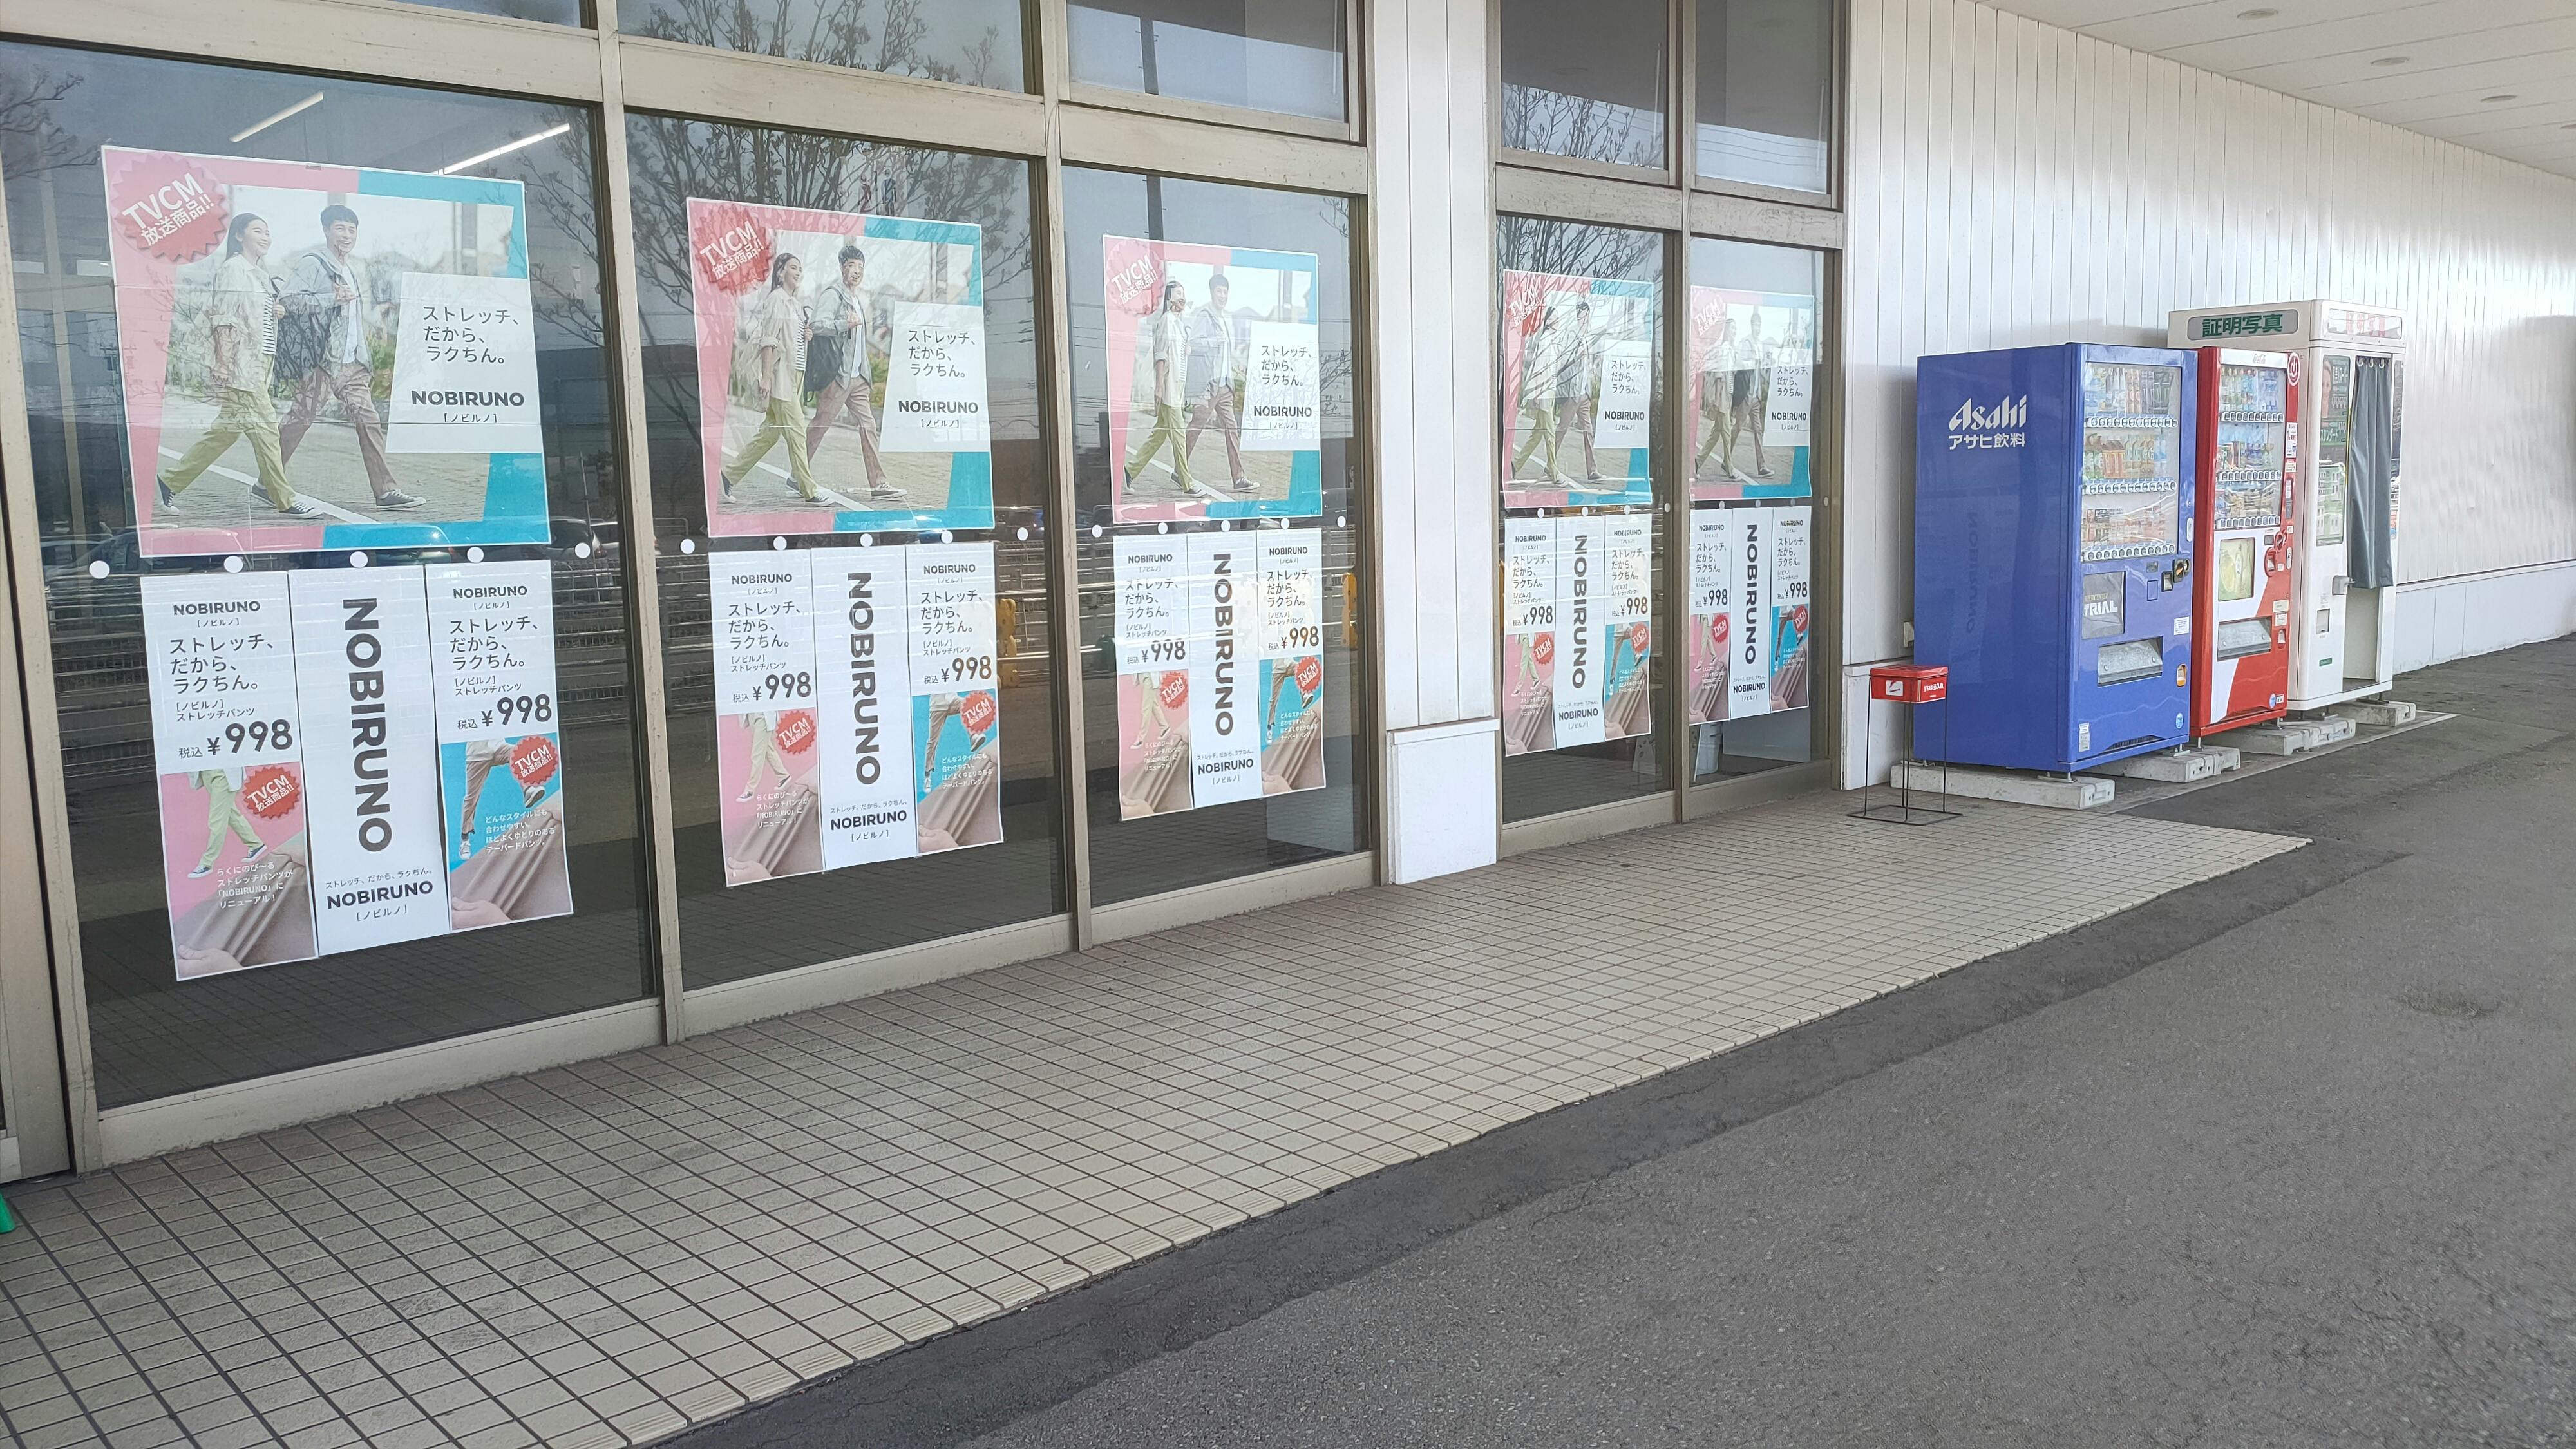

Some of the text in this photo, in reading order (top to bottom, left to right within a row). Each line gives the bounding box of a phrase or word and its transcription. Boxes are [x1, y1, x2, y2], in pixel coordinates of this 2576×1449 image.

[122, 173, 204, 229] TVCM
[699, 220, 757, 266] TVCM
[1111, 254, 1153, 292] TVCM
[423, 306, 518, 325] ストレッチ、
[2202, 314, 2283, 337] 証明写真
[423, 326, 484, 343] だから、
[908, 330, 976, 346] ストレッチ、
[426, 346, 504, 364] ラクちん。
[908, 346, 952, 362] だから、
[1262, 345, 1311, 357] ストレッチ、
[910, 363, 965, 378] ラクちん。
[1262, 359, 1293, 371] だから、
[1262, 374, 1303, 386] ラクちん。
[1611, 372, 1634, 382] だから、
[1777, 377, 1797, 386] だから、
[411, 390, 524, 406] NOBIRUNO
[1777, 388, 1803, 397] ラクちん。
[898, 401, 978, 413] NOBIRUNO
[1254, 406, 1312, 417] NOBIRUNO
[1949, 394, 2027, 431] Asahi
[1605, 410, 1645, 421] NOBIRUNO
[1772, 412, 1806, 421] NOBIRUNO
[1949, 432, 2025, 450] アサヒ飲料
[1128, 554, 1172, 564] NOBIRUNO
[1269, 547, 1308, 556] NOBIRUNO
[1513, 554, 1549, 565] ストレッチ、
[924, 564, 976, 574] NOBIRUNO
[1513, 567, 1536, 577] だから、
[732, 574, 792, 584] NOBIRUNO
[1513, 579, 1544, 589] ラクちん。
[453, 585, 527, 599] NOBIRUNO
[921, 590, 983, 603] ストレッチ、
[1267, 583, 1296, 595] だから、
[1745, 524, 1758, 665] NOBIRUNO
[1125, 593, 1158, 605] だから、
[1267, 595, 1305, 607] ラクちん。
[173, 601, 260, 616] NOBIRUNO
[729, 601, 800, 616] ストレッチ、
[921, 607, 960, 620] だから、
[1126, 606, 1169, 619] ラクちん。
[1572, 535, 1587, 688] NOBIRUNO
[2084, 600, 2118, 617] TRIAL
[450, 616, 538, 634] ストレッチ、
[729, 619, 774, 634] だから、
[922, 621, 972, 634] ラクちん。
[170, 633, 273, 654] ストレッチ、
[450, 636, 507, 653] だから、
[730, 634, 788, 650] ラクちん。
[1213, 553, 1234, 736] NOBIRUNO
[170, 656, 236, 675] だから、
[453, 653, 524, 671] ラクちん。
[731, 662, 786, 672] ストレッチパンツ
[848, 573, 880, 784] NOBIRUNO
[1298, 661, 1317, 681] TVCM
[173, 675, 258, 694] ラクちん。
[455, 683, 522, 696] ストレッチパンツ
[1162, 677, 1183, 698] TVCM
[1733, 682, 1765, 694] NOBIRUNO
[176, 708, 255, 722] ストレッチパンツ
[963, 698, 989, 719] TVCM
[1559, 708, 1598, 721] NOBIRUNO
[343, 598, 392, 853] NOBIRUNO
[457, 719, 478, 730] 税込
[779, 717, 809, 741] TVCM
[178, 747, 203, 759] 税込
[515, 744, 549, 770] TVCM
[1198, 758, 1254, 775] NOBIRUNO
[247, 774, 290, 804] TVCM
[831, 810, 907, 830] NOBIRUNO
[217, 870, 293, 887] ストレッチパンツが
[327, 880, 433, 909] NOBIRUNO
